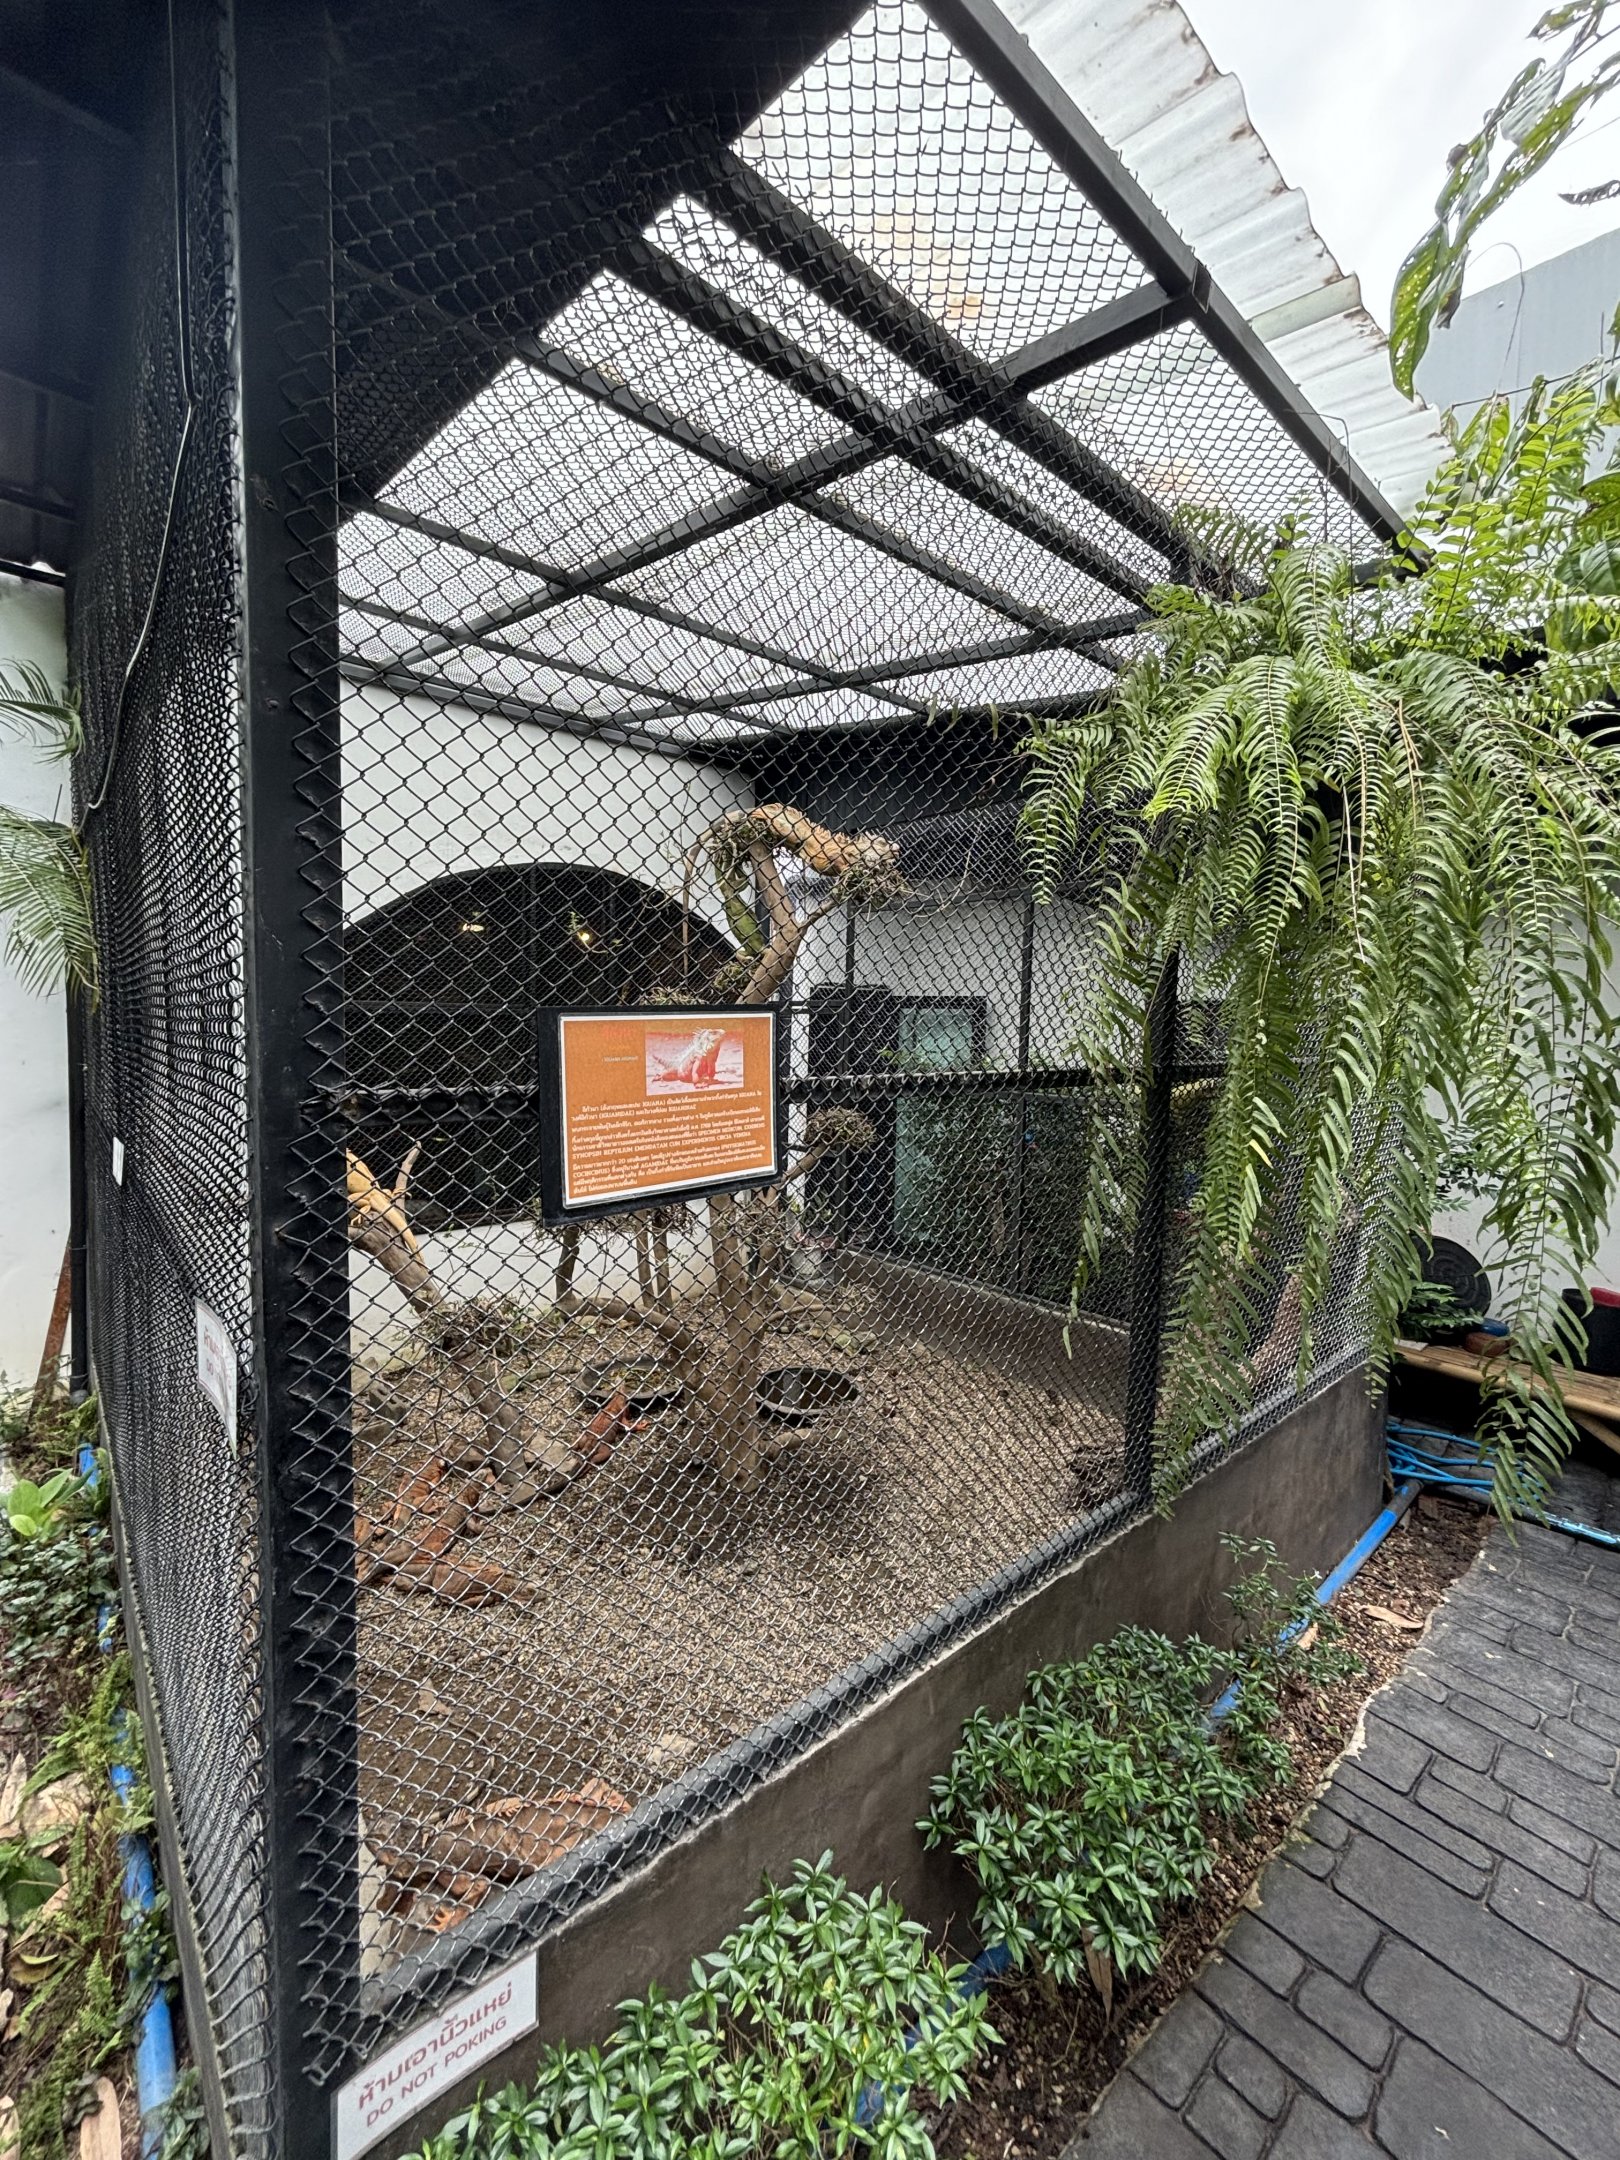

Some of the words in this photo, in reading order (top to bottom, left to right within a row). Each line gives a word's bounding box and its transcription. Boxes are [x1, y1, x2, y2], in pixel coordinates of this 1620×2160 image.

[358, 1981, 513, 2110] ห้ามเอานิ้วแหย่
[366, 2098, 394, 2128] DO
[401, 2063, 438, 2100] NOT
[444, 2016, 507, 2068] POKING
